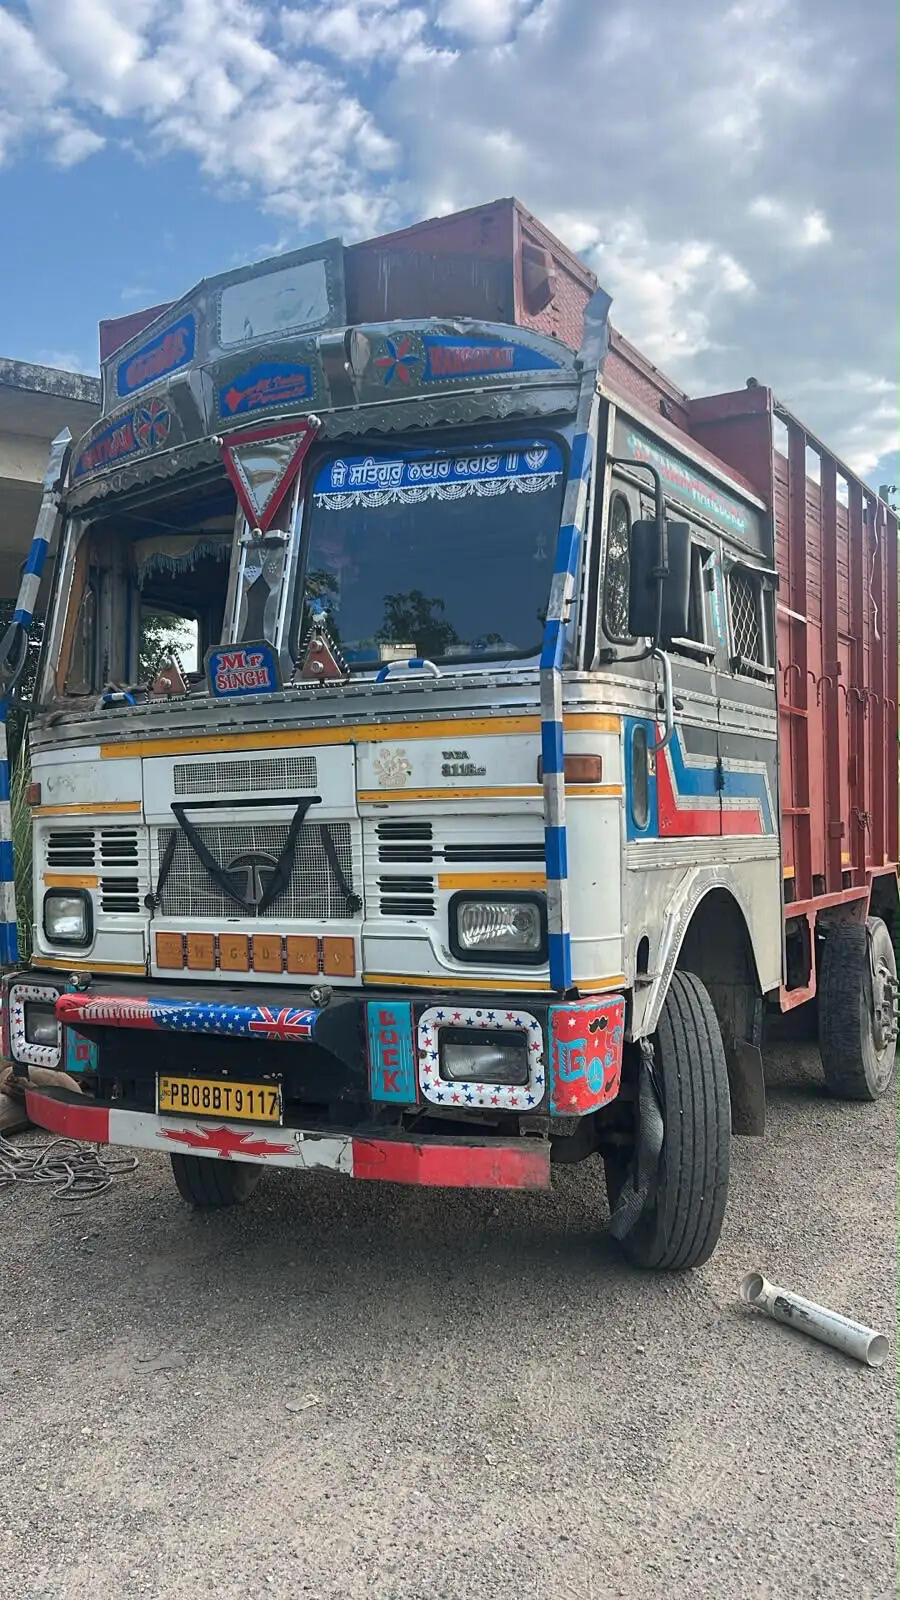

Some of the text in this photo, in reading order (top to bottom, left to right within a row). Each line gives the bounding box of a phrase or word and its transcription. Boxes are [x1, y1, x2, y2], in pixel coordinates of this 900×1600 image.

[215, 668, 271, 691] SINGH
[441, 750, 470, 760] TATA
[171, 1083, 279, 1115] PB08BT9117
